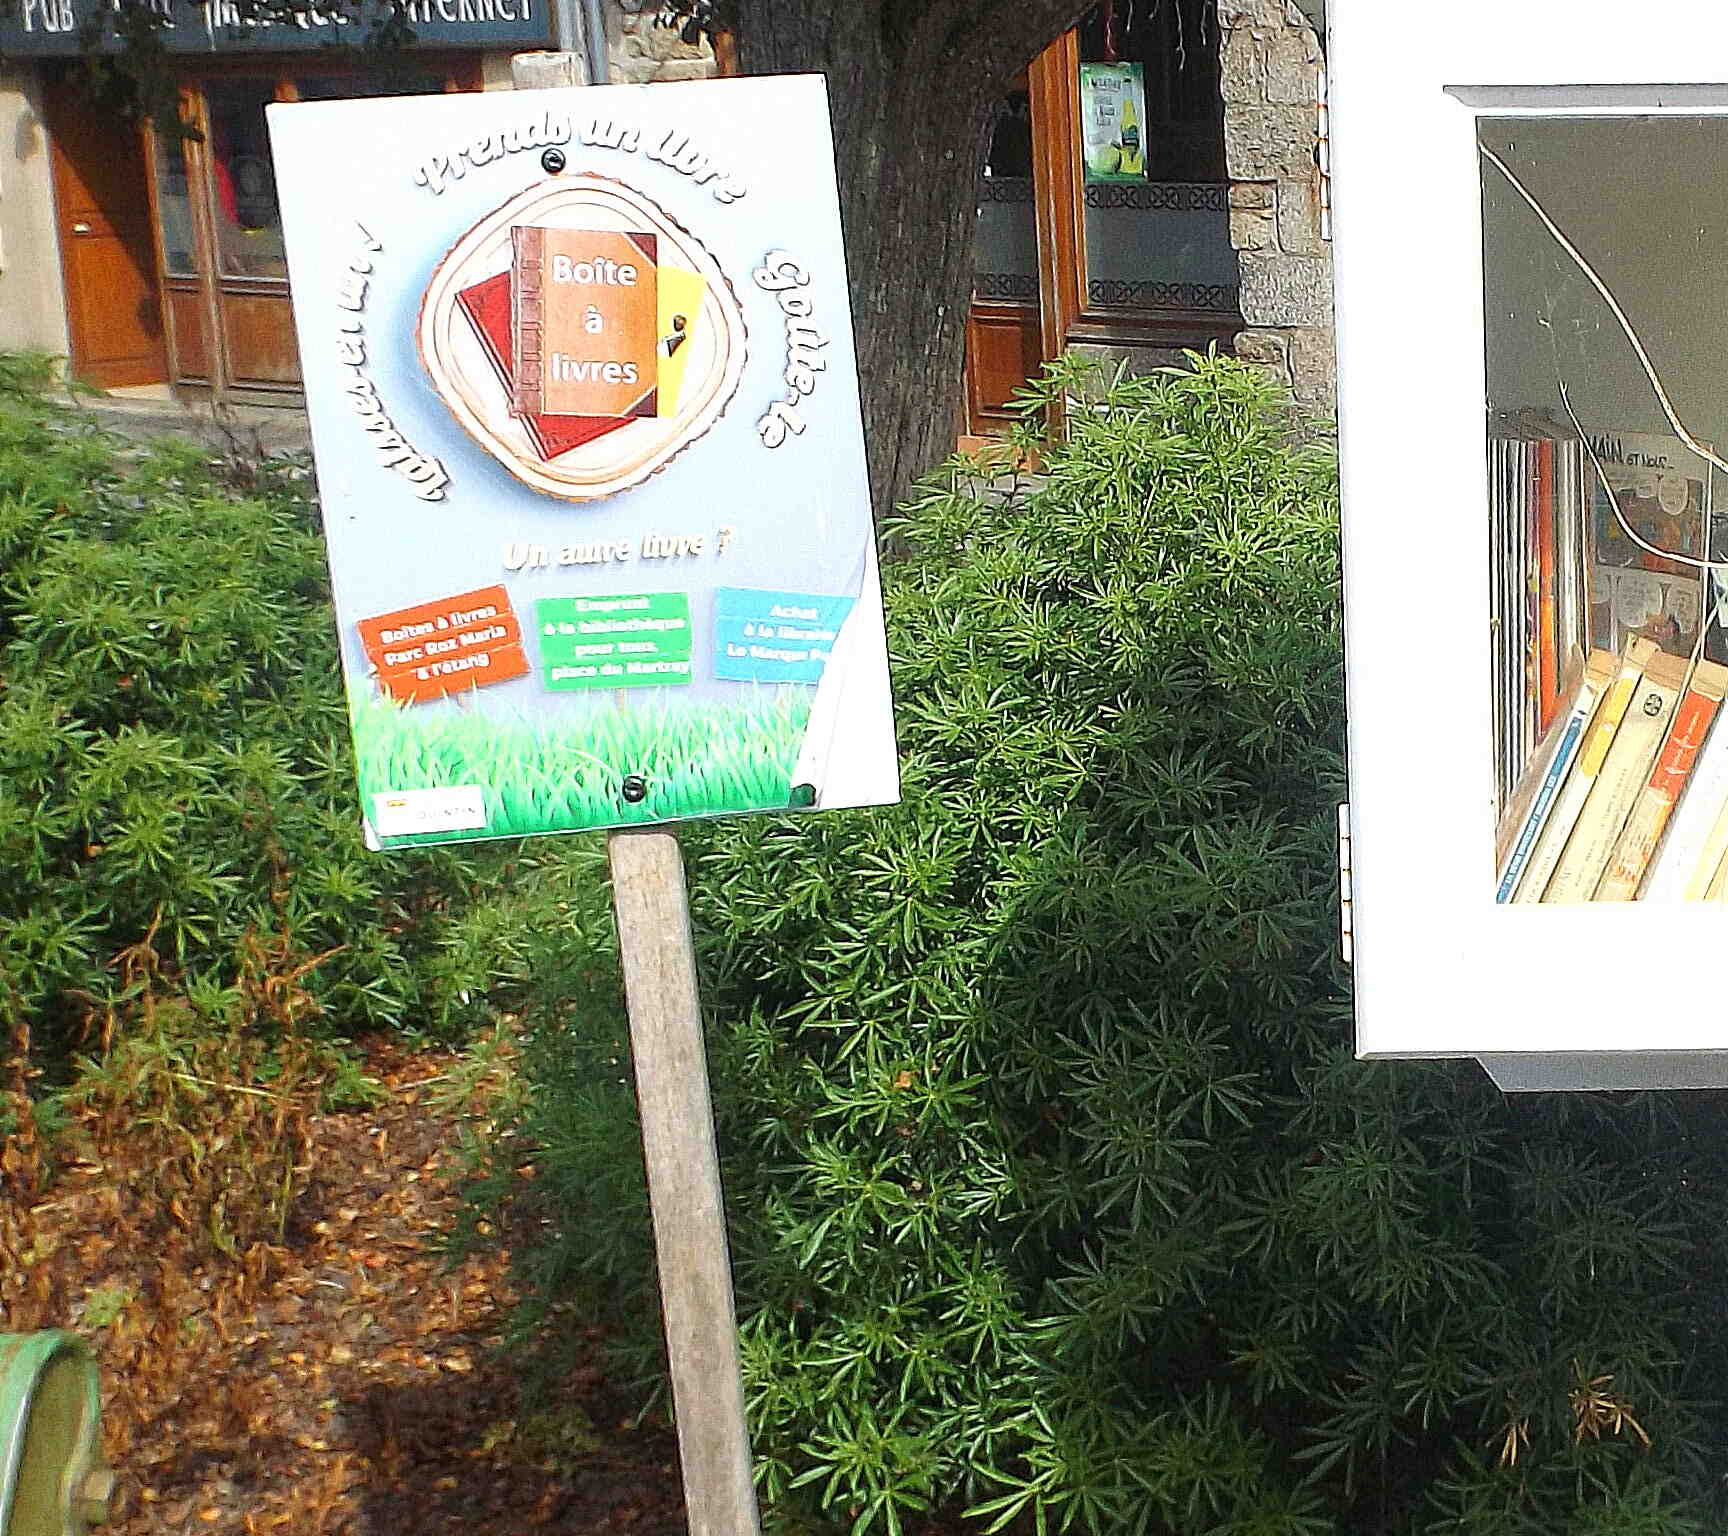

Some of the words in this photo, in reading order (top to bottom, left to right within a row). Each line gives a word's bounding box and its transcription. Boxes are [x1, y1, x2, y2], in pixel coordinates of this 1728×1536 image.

[414, 112, 572, 195] Prends
[580, 119, 641, 154] un
[646, 127, 746, 204] livre
[551, 254, 638, 288] Boîte
[583, 305, 604, 334] à
[551, 353, 639, 385] livres
[504, 542, 547, 571] Un
[450, 604, 496, 627] livres
